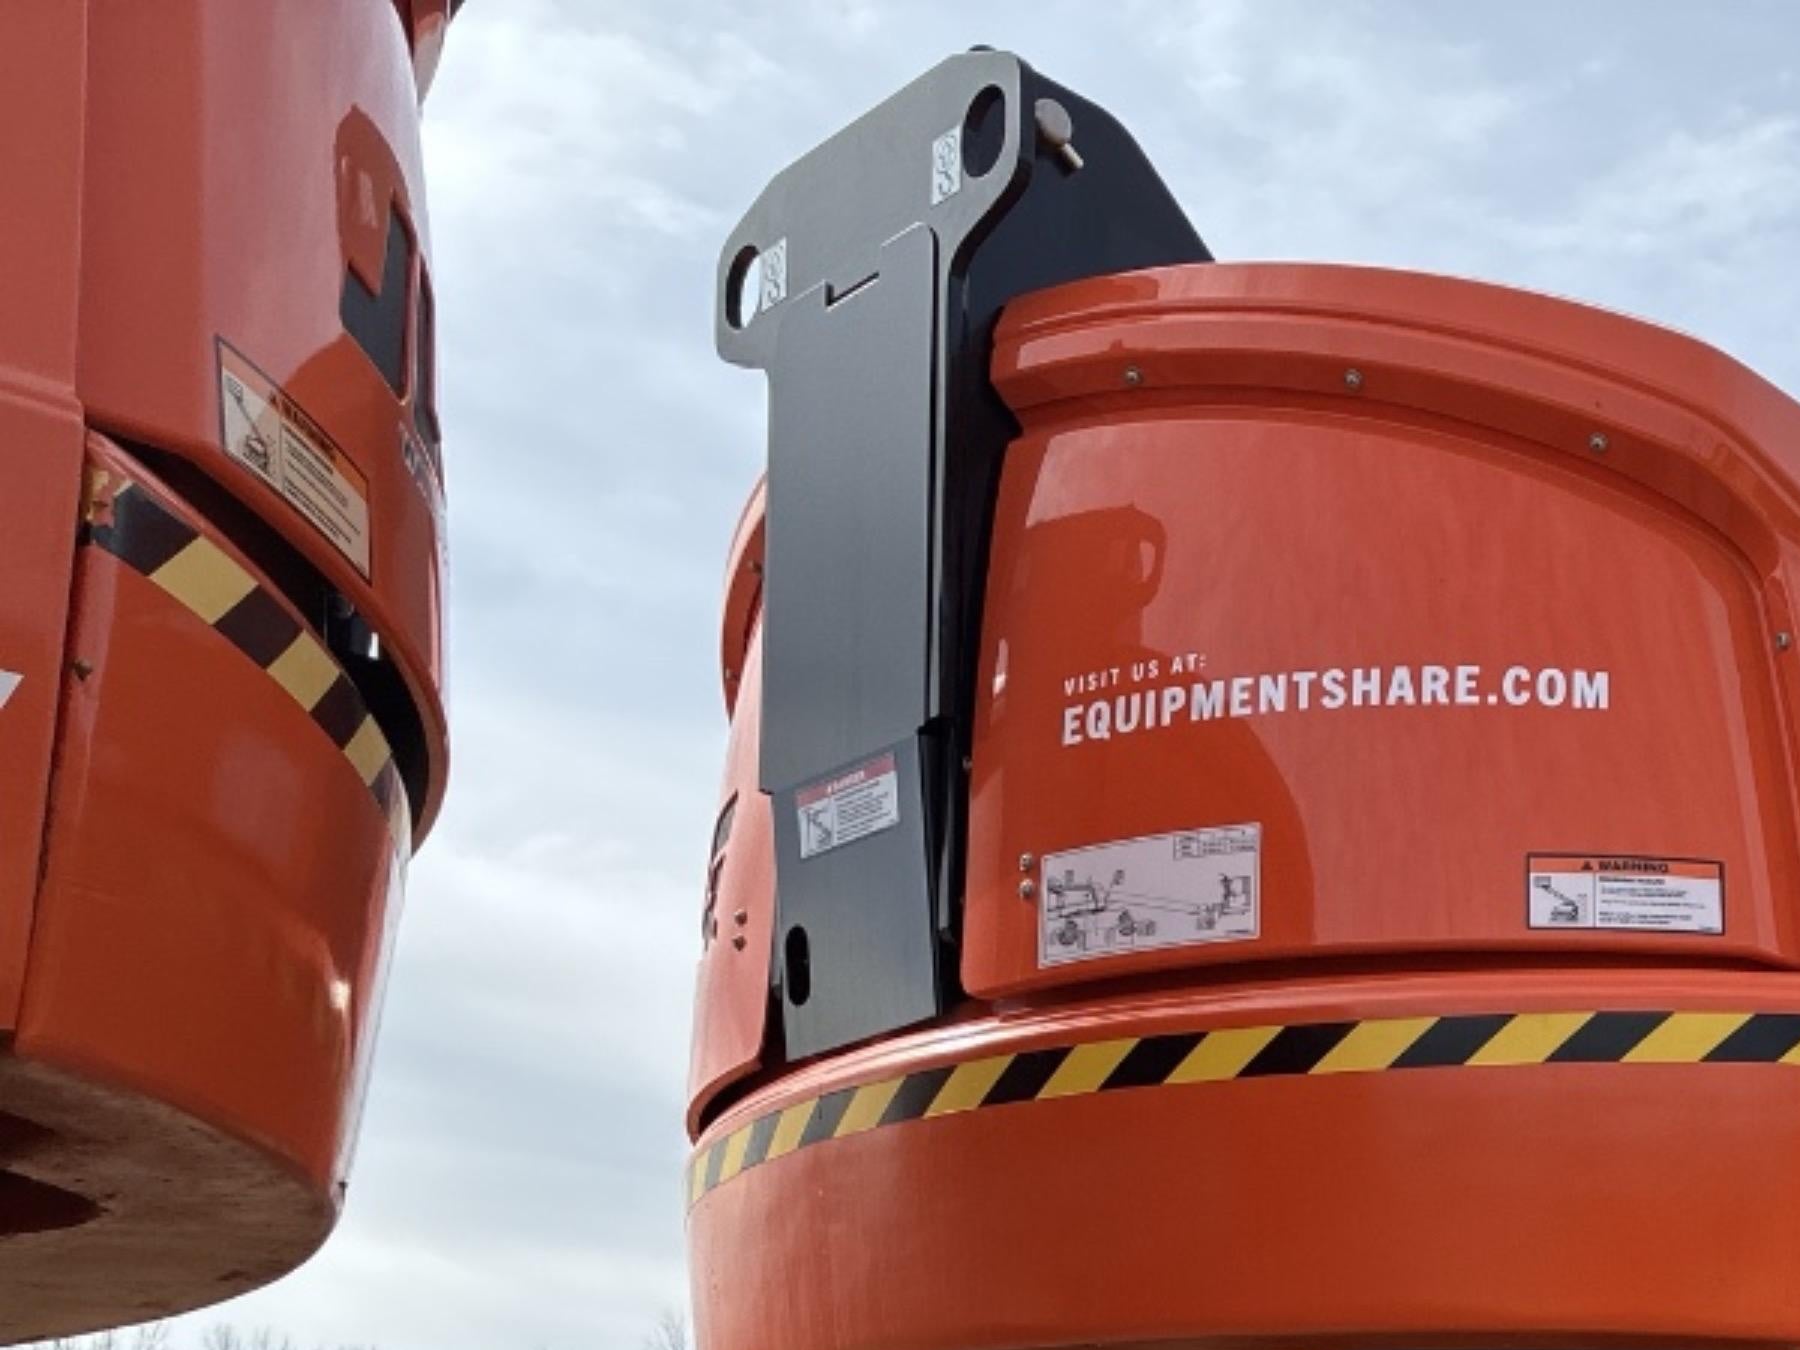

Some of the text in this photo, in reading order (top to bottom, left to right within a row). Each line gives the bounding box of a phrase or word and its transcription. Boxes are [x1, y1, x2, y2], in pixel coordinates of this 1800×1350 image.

[1061, 664, 1610, 747] EQUIPMENTSHARE.COM
[1063, 652, 1206, 697] VISIT US AT:
